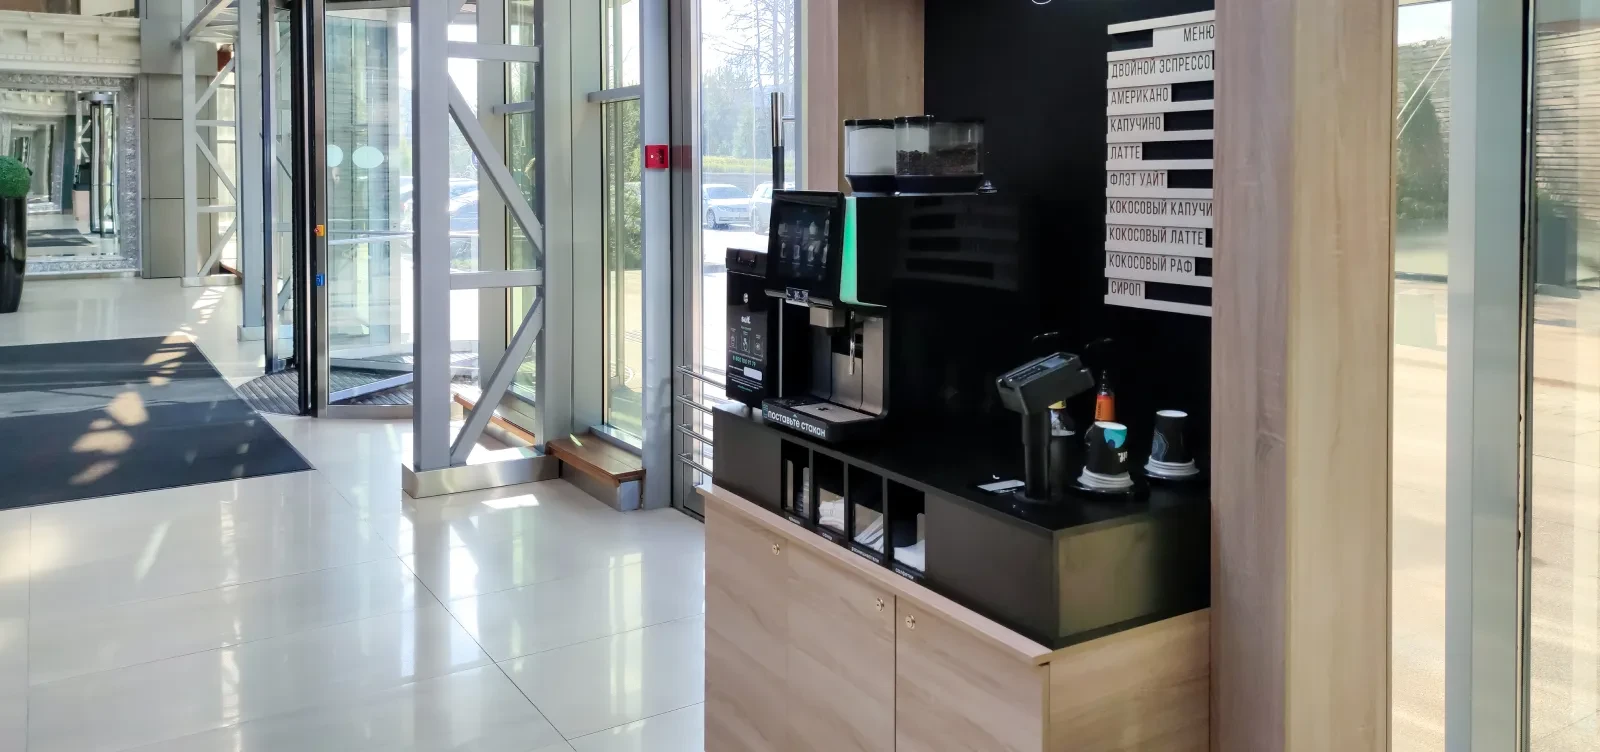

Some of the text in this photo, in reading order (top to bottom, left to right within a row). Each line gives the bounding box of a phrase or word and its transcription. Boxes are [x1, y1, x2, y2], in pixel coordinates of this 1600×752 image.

[1183, 24, 1215, 42] МЕНЮ
[1111, 54, 1211, 79] ДВОЙНОЙ ЭСПРЕССО
[1110, 87, 1169, 106] АМЕРИКАНО
[1110, 116, 1161, 132] КАПУЧИНО
[1110, 145, 1141, 160] ЛАТТЕ
[1110, 170, 1166, 187] ФЛЭТ УАЙТ
[1109, 198, 1167, 215] КОКОСОВЫЙ
[1109, 227, 1204, 246] КОКОСОВЫЙ ЛАТТЕ
[1108, 254, 1193, 273] КОКОСОВЫЙ РАФ
[1111, 280, 1141, 297] СИРОП
[767, 410, 800, 428] поставьте
[801, 421, 826, 438] стакан
